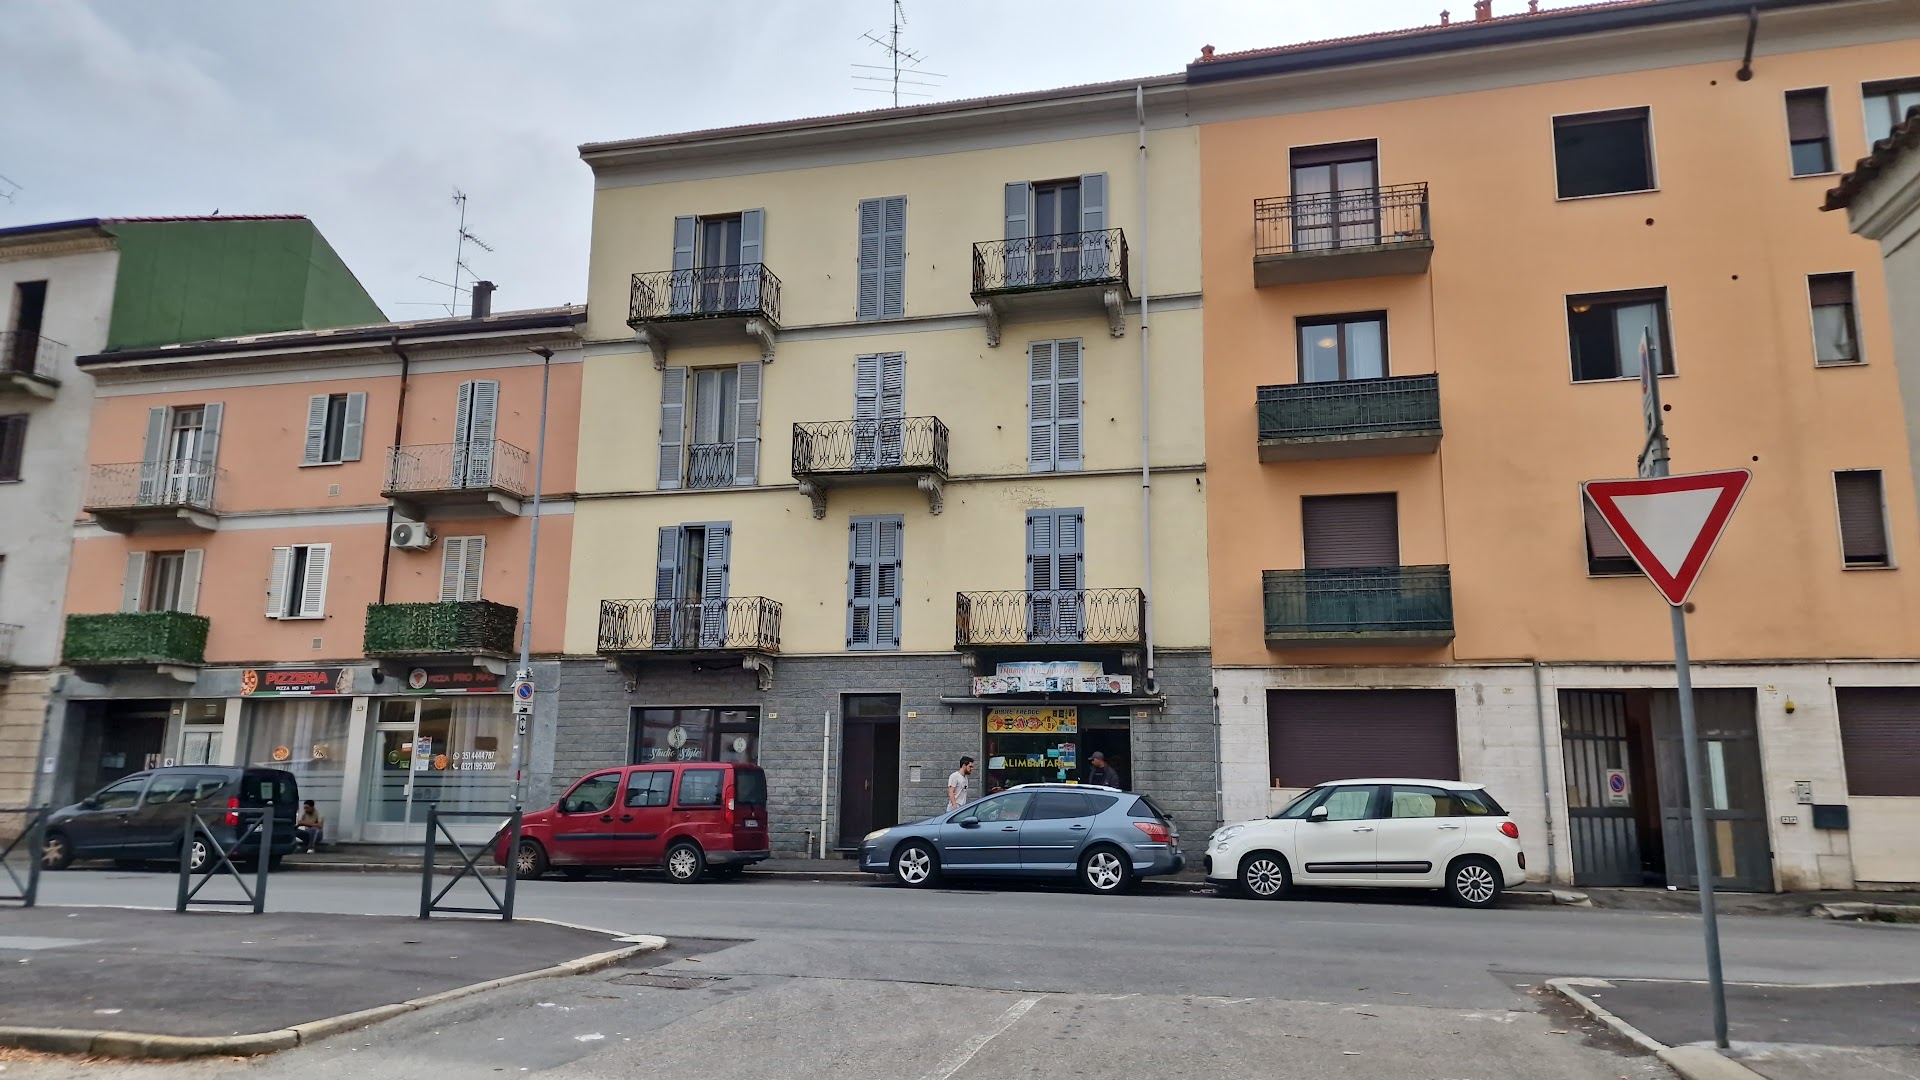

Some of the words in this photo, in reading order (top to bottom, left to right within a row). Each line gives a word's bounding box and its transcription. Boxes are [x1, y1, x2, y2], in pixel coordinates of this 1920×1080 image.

[265, 671, 328, 685] PIZZERIA
[428, 674, 450, 683] PIZZA
[453, 672, 473, 682] PRO
[461, 751, 471, 760] 351
[649, 748, 675, 760] Studio
[678, 748, 701, 760] Style
[461, 762, 473, 770] 0321
